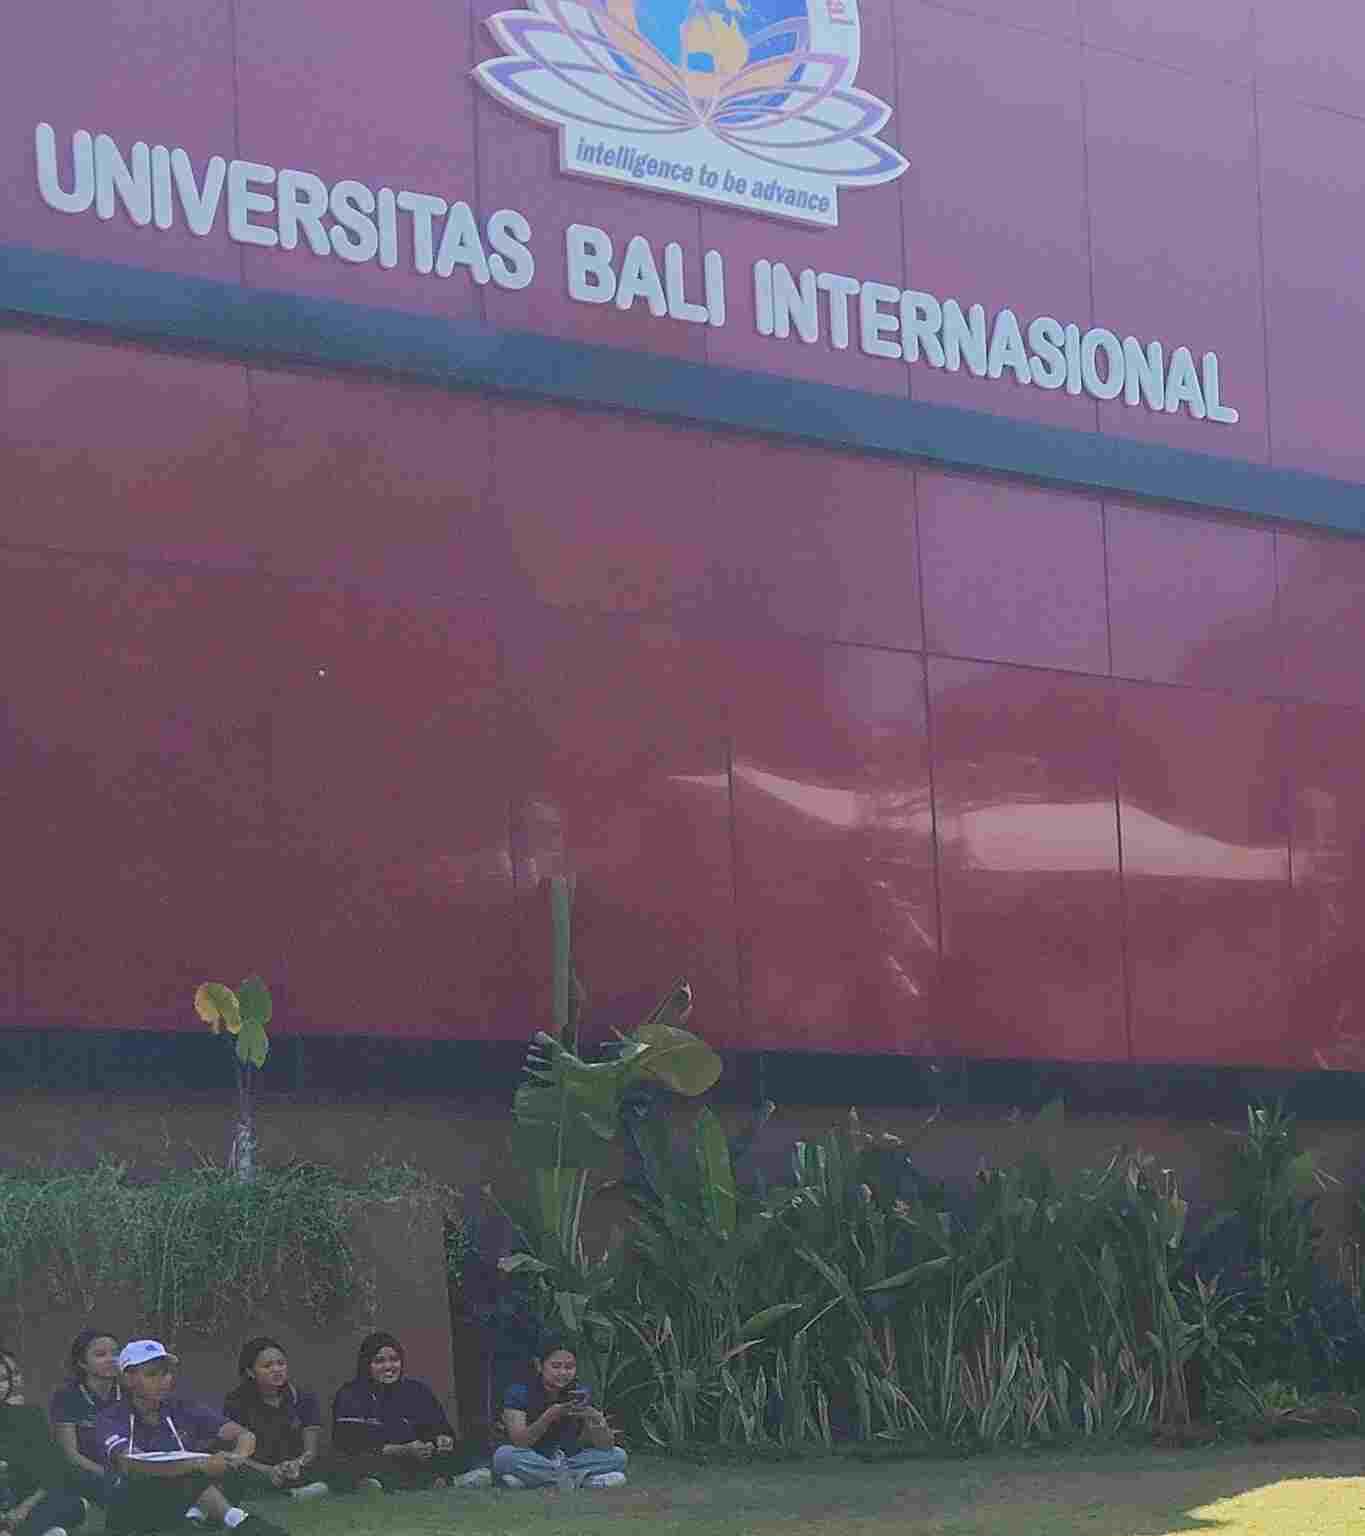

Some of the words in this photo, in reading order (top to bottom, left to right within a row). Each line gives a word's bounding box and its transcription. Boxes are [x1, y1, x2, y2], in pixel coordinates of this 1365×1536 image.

[575, 137, 693, 183] intelligence
[698, 164, 720, 189] to
[723, 168, 748, 195] be
[751, 176, 830, 213] advance
[34, 121, 535, 291] UNIVERSITAS
[566, 223, 726, 328] BALI
[753, 258, 1240, 425] INTERNASIONAL
